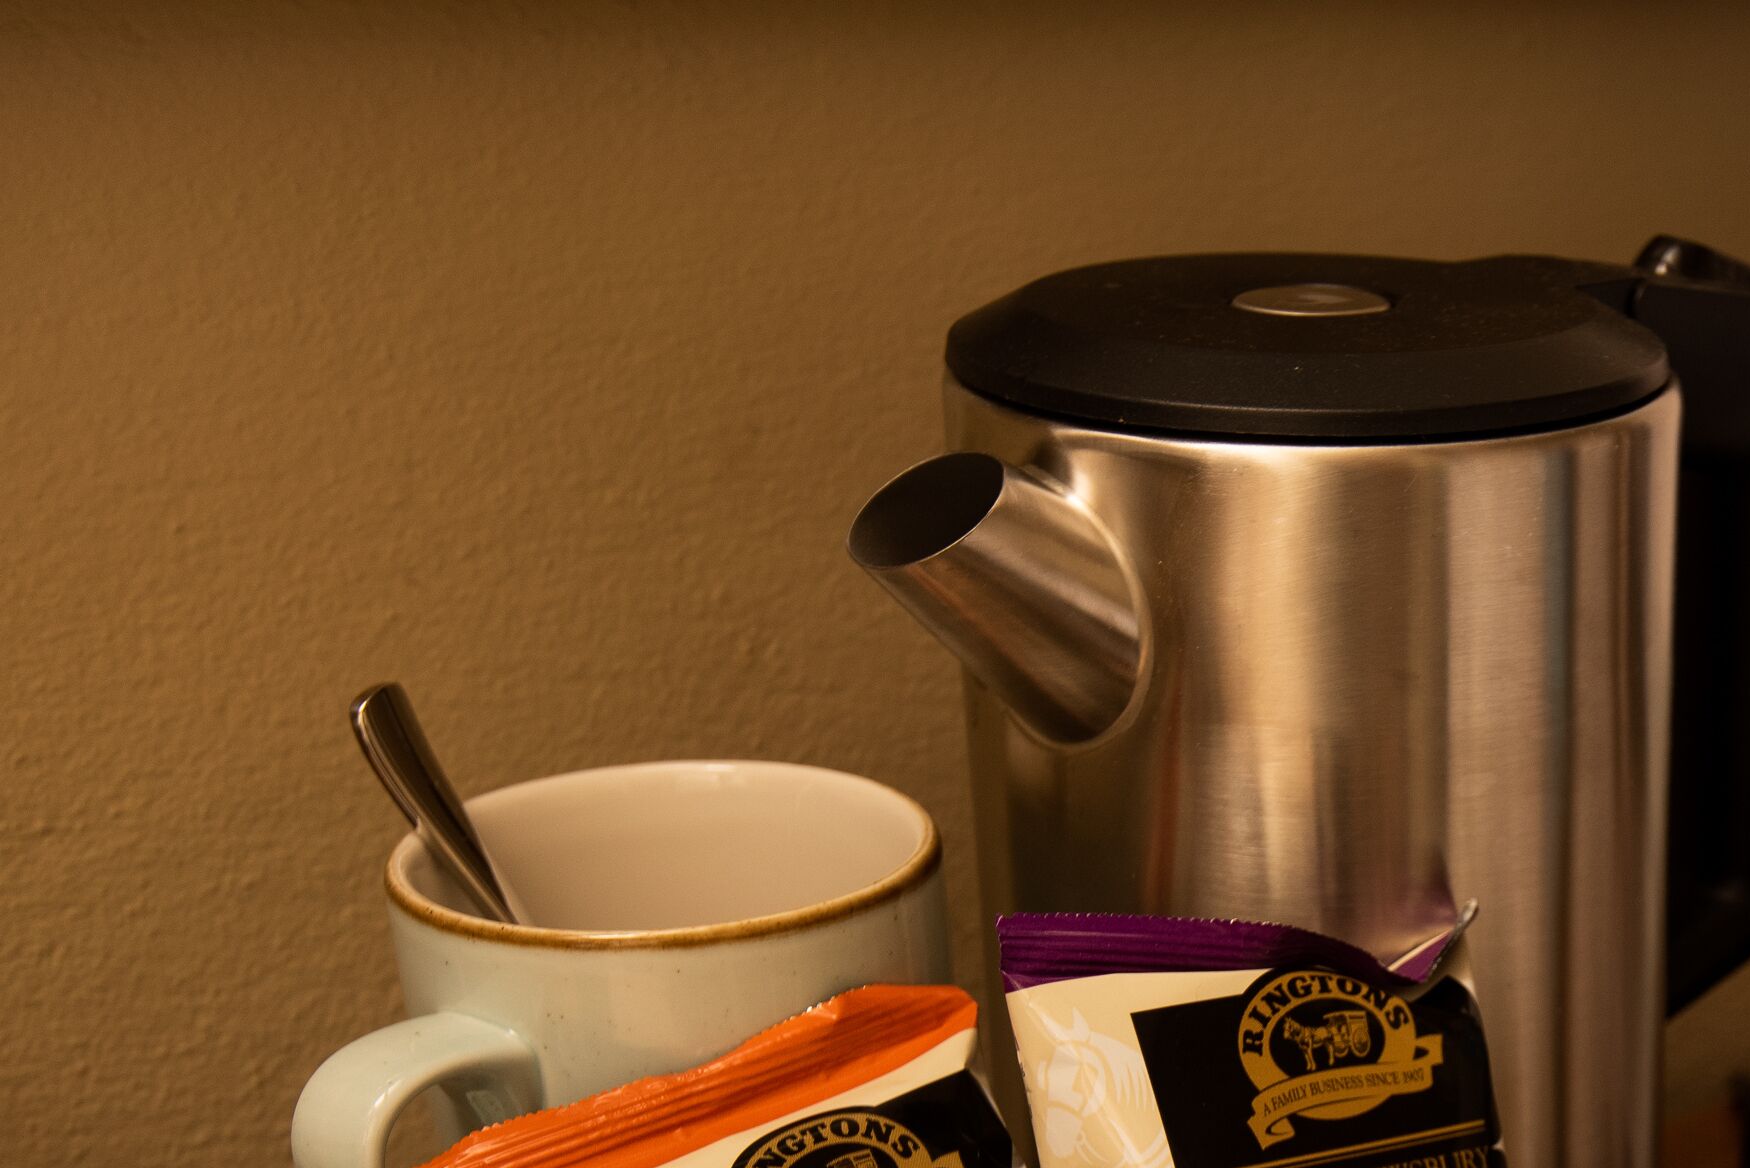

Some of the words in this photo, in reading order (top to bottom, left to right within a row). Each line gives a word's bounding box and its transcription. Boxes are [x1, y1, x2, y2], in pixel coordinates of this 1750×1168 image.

[1242, 974, 1410, 1058] RINGTONS
[1263, 1103, 1273, 1117] A
[1272, 1085, 1308, 1112] FAMILY
[1310, 1074, 1365, 1097] BUSINESS
[1366, 1071, 1399, 1087] SINCE
